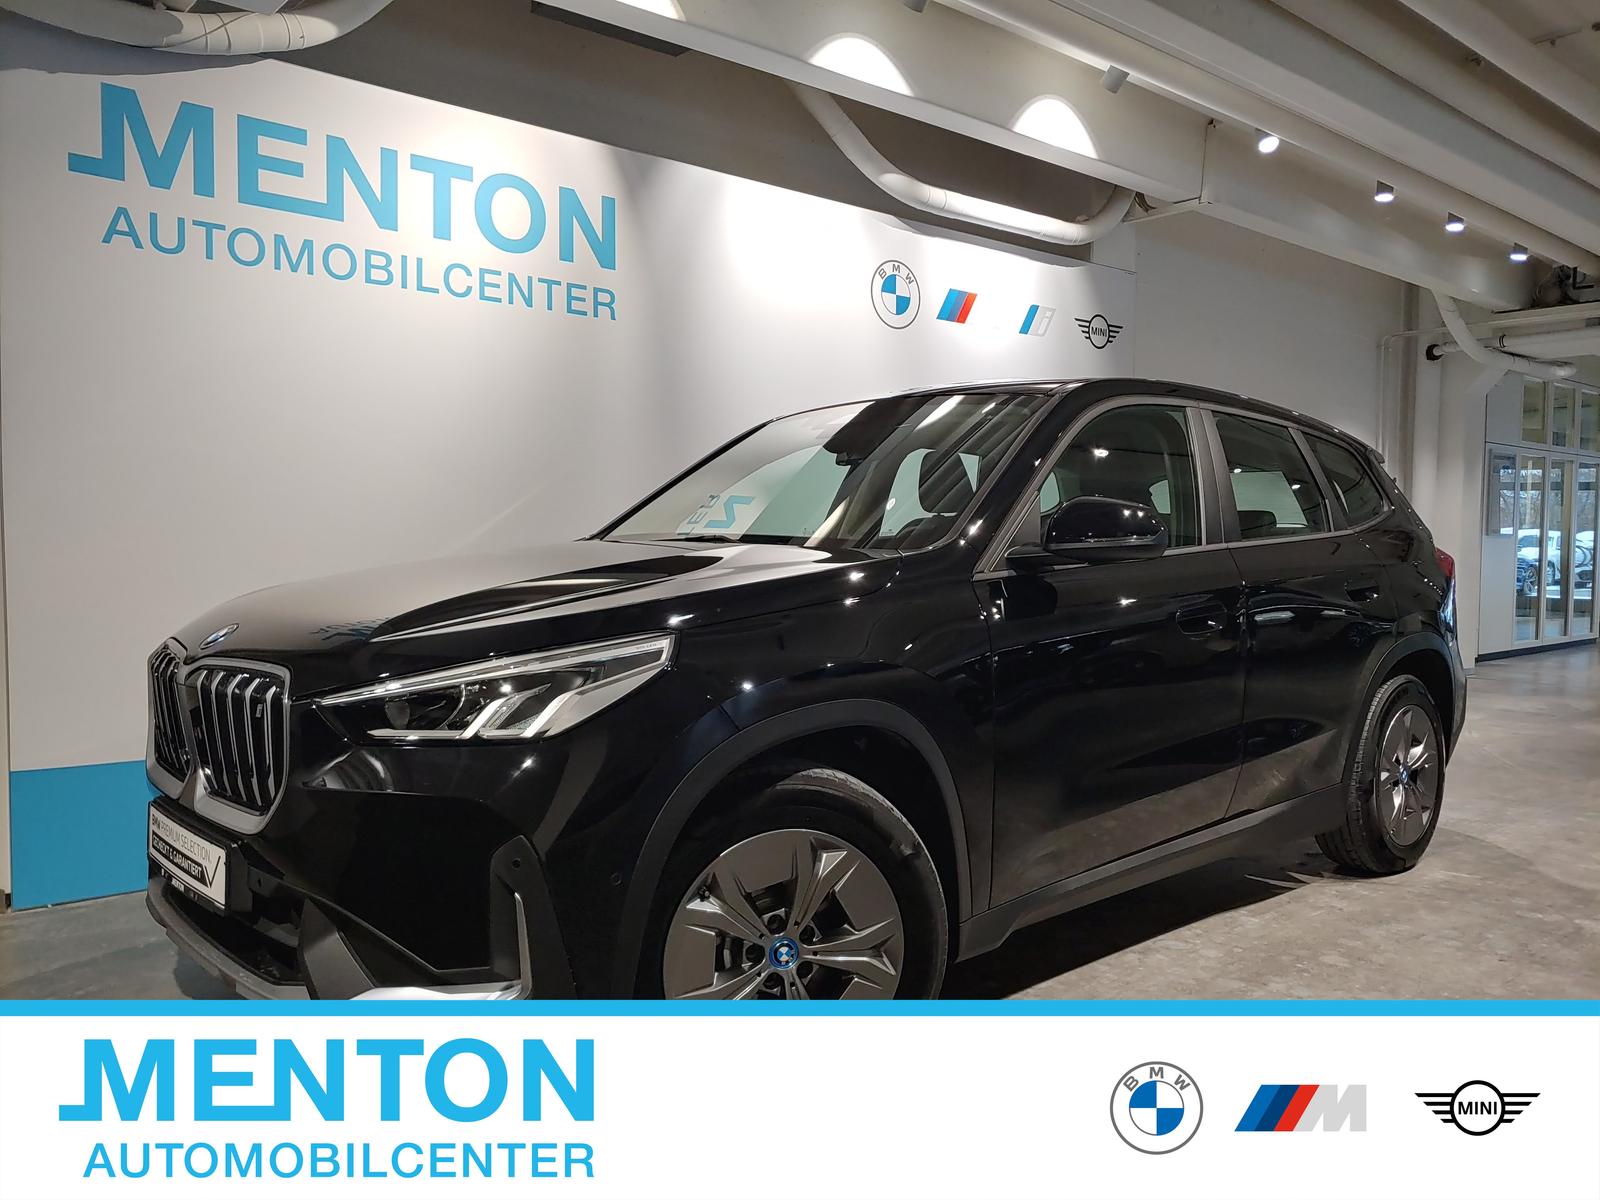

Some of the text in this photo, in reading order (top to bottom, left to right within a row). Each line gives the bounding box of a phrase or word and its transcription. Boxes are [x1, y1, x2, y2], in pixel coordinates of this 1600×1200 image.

[68, 82, 617, 271] MENTON
[102, 206, 617, 321] AUTOMOBILCENTER
[878, 263, 914, 285] BMW
[1090, 325, 1108, 338] MINI
